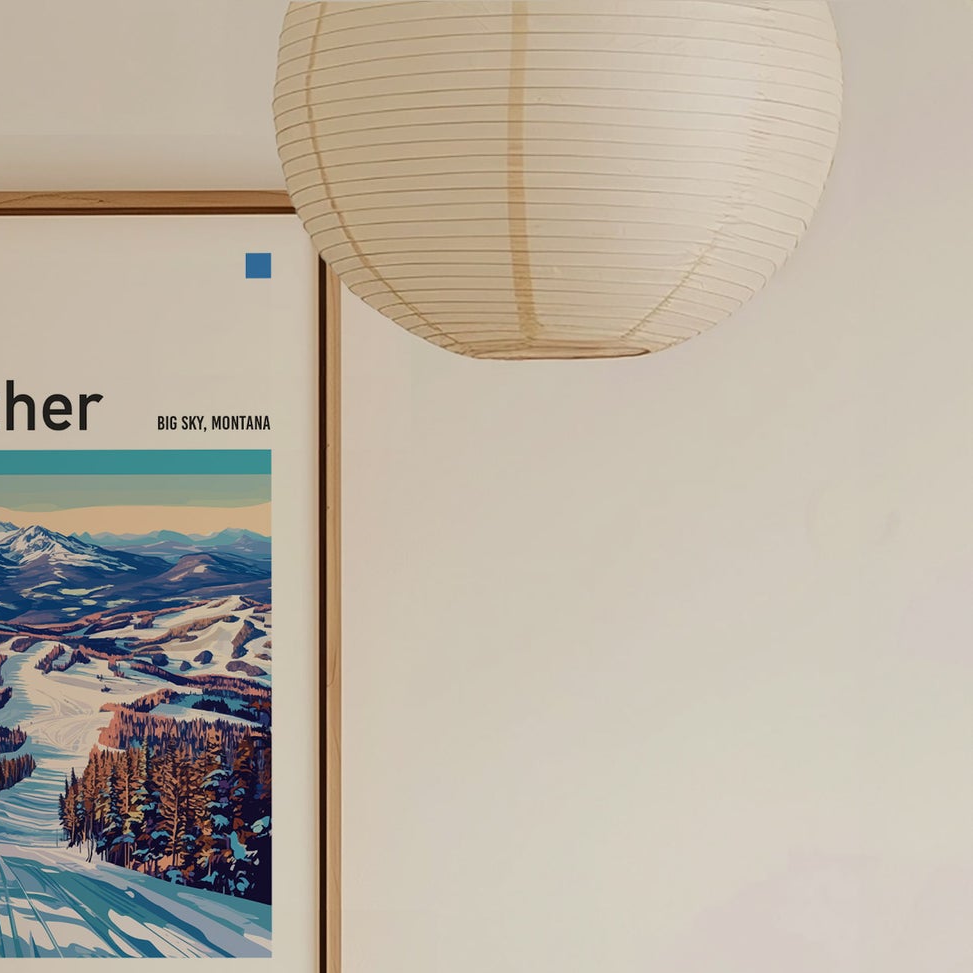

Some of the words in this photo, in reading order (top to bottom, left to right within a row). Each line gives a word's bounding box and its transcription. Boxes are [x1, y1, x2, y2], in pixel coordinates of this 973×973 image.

[157, 415, 178, 431] BIG
[181, 415, 208, 433] SKY,
[211, 415, 271, 431] MONTANA
